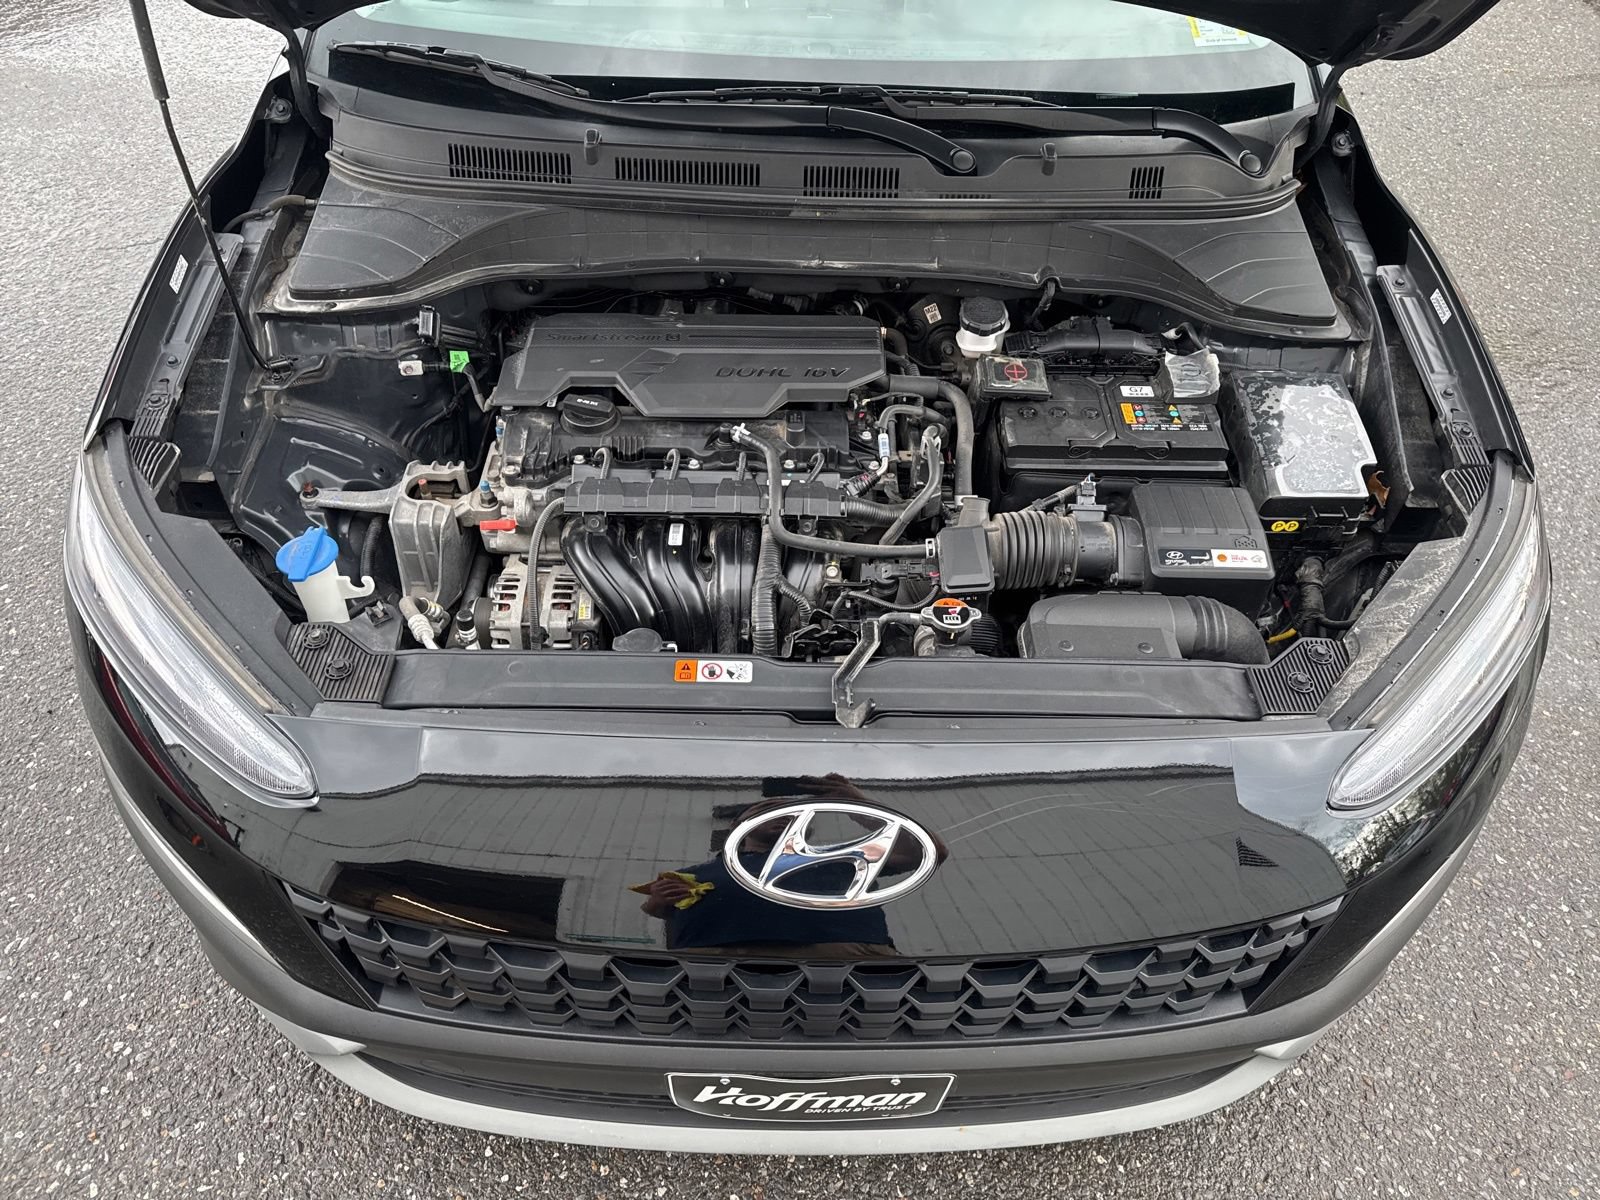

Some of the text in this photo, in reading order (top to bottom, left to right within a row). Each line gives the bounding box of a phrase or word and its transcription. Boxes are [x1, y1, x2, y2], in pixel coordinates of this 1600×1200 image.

[804, 367, 850, 377] 16V
[693, 1085, 927, 1112] Hoffman
[872, 1104, 912, 1112] TRUST
